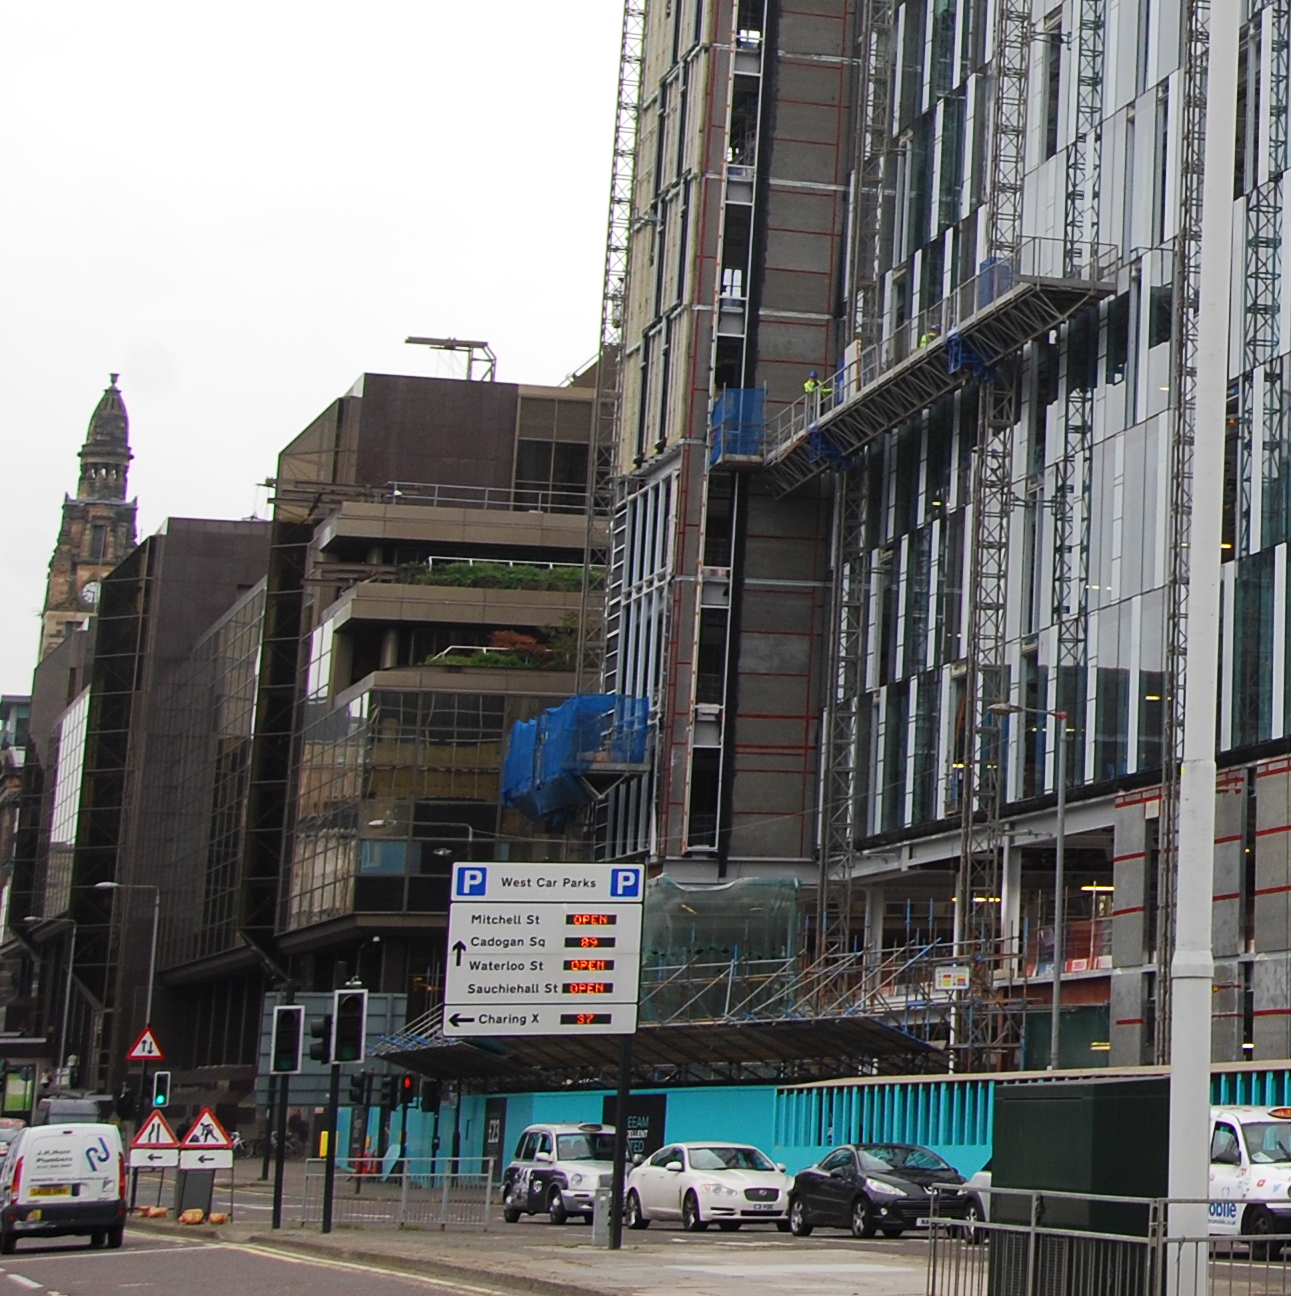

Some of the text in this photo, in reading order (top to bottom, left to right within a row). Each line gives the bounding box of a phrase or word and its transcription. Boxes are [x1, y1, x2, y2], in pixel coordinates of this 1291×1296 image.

[463, 870, 483, 894] P
[501, 878, 596, 888] West Car Parks
[617, 871, 636, 895] P
[471, 914, 540, 924] Mitchell St
[573, 914, 608, 925] OPEN
[471, 937, 545, 948] Cadogan Sq
[581, 937, 598, 947] 89
[469, 961, 544, 971] Waterloo St
[571, 960, 605, 971] OPEN
[467, 984, 558, 994] Sauchiehall St
[569, 983, 604, 994] OPEN
[478, 1014, 539, 1025] Charing X
[577, 1014, 594, 1024] 37
